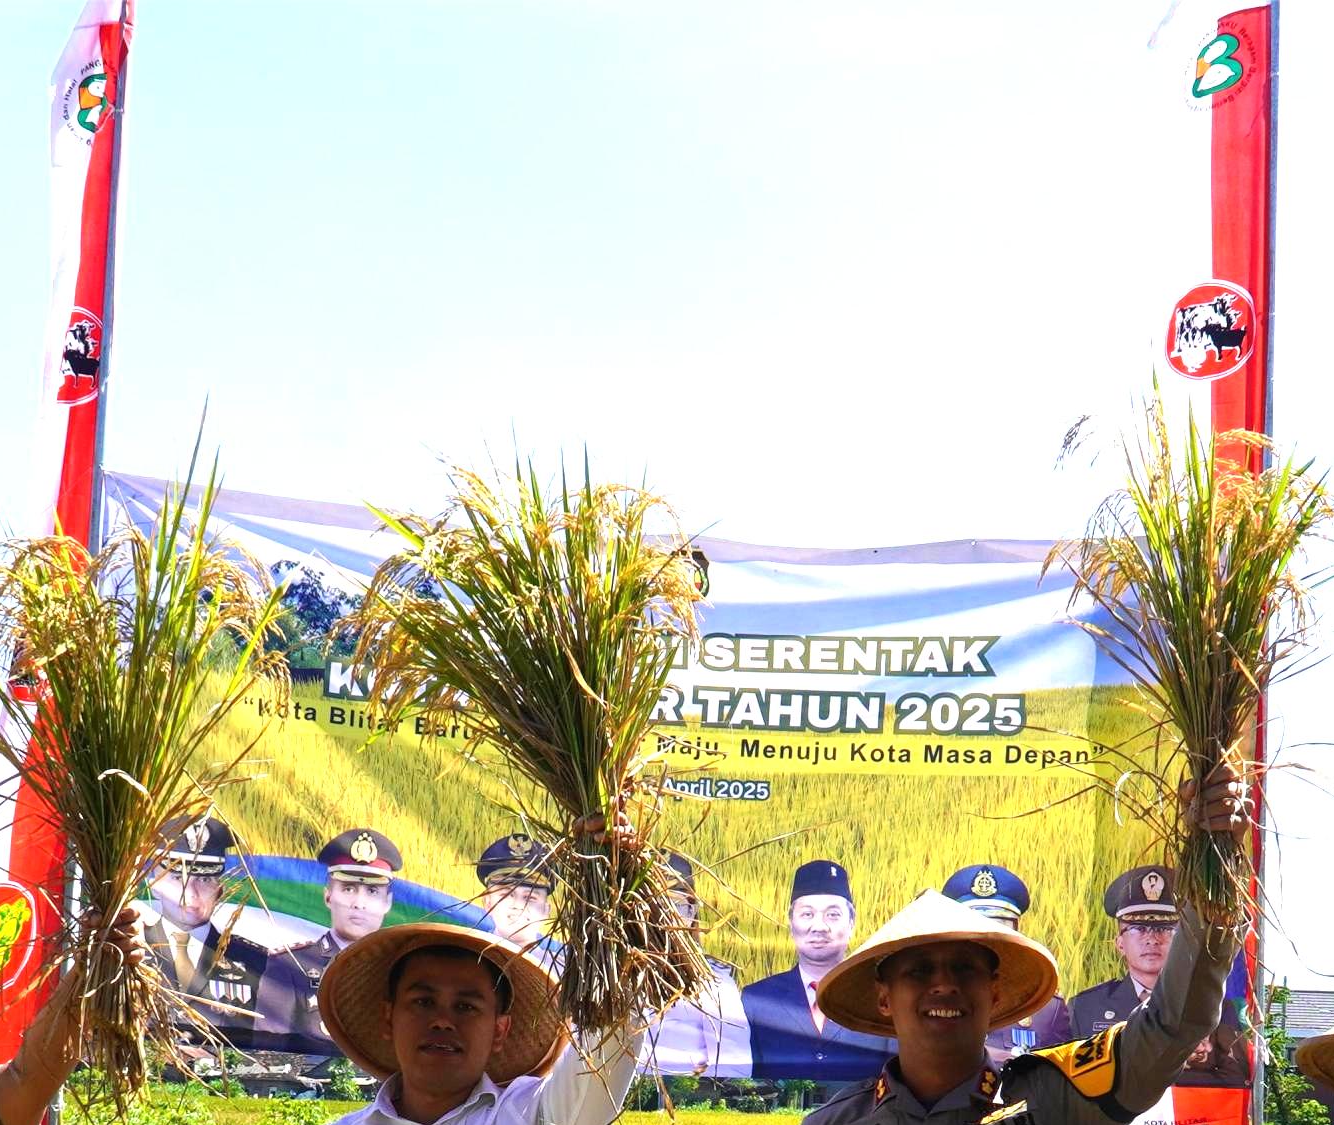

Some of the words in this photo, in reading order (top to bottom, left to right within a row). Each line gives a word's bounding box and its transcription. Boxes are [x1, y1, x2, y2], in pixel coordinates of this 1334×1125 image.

[703, 635, 995, 675] SERENTAK
[695, 688, 884, 732] TAHUN
[896, 694, 1025, 734] 2025
[740, 739, 837, 765] Menuju
[851, 743, 911, 764] Kota
[924, 745, 992, 764] Masa
[663, 777, 711, 800] April
[717, 780, 769, 799] 2025
